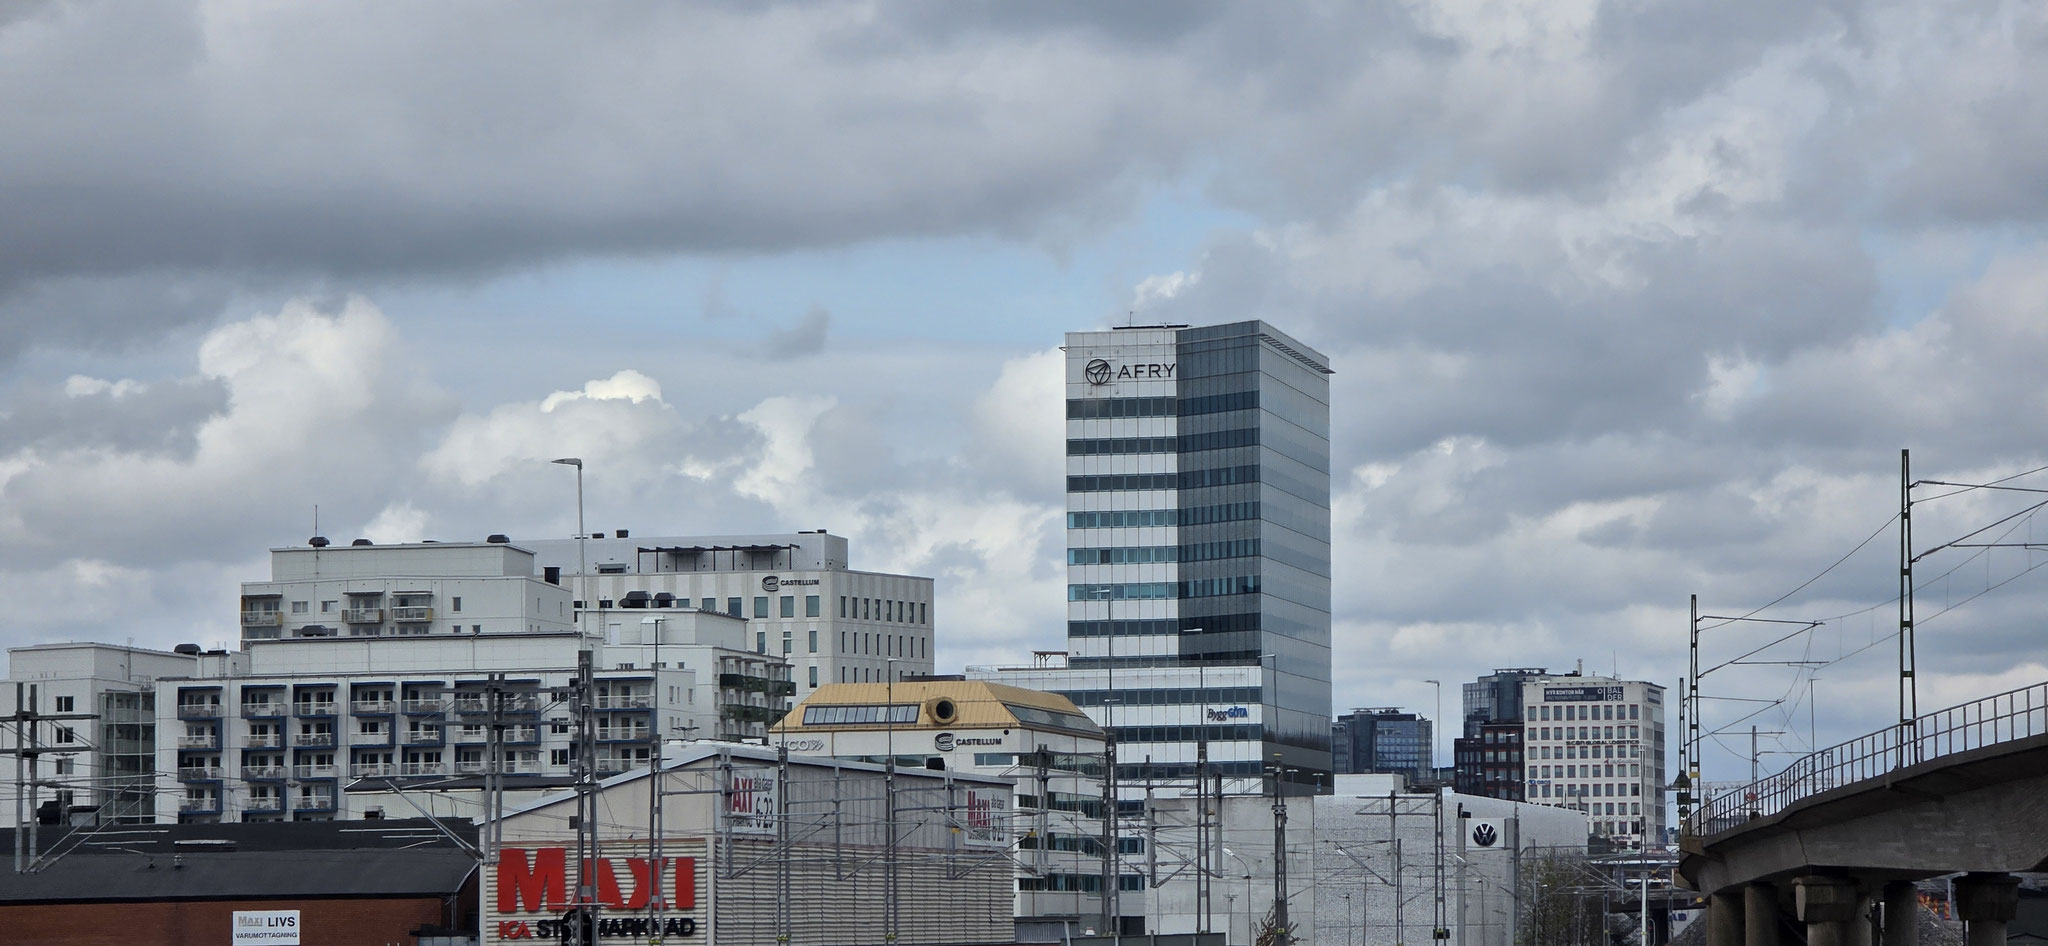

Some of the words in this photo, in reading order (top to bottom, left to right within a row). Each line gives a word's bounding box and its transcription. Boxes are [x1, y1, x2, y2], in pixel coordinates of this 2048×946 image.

[1117, 363, 1176, 379] AFRY
[956, 738, 1002, 746] CASTELLUM
[729, 775, 752, 813] AXI
[755, 796, 774, 829] 6-23
[967, 790, 991, 828] MAXI
[497, 847, 695, 912] MAXI
[268, 916, 295, 927] LIVS
[499, 920, 532, 939] ICA
